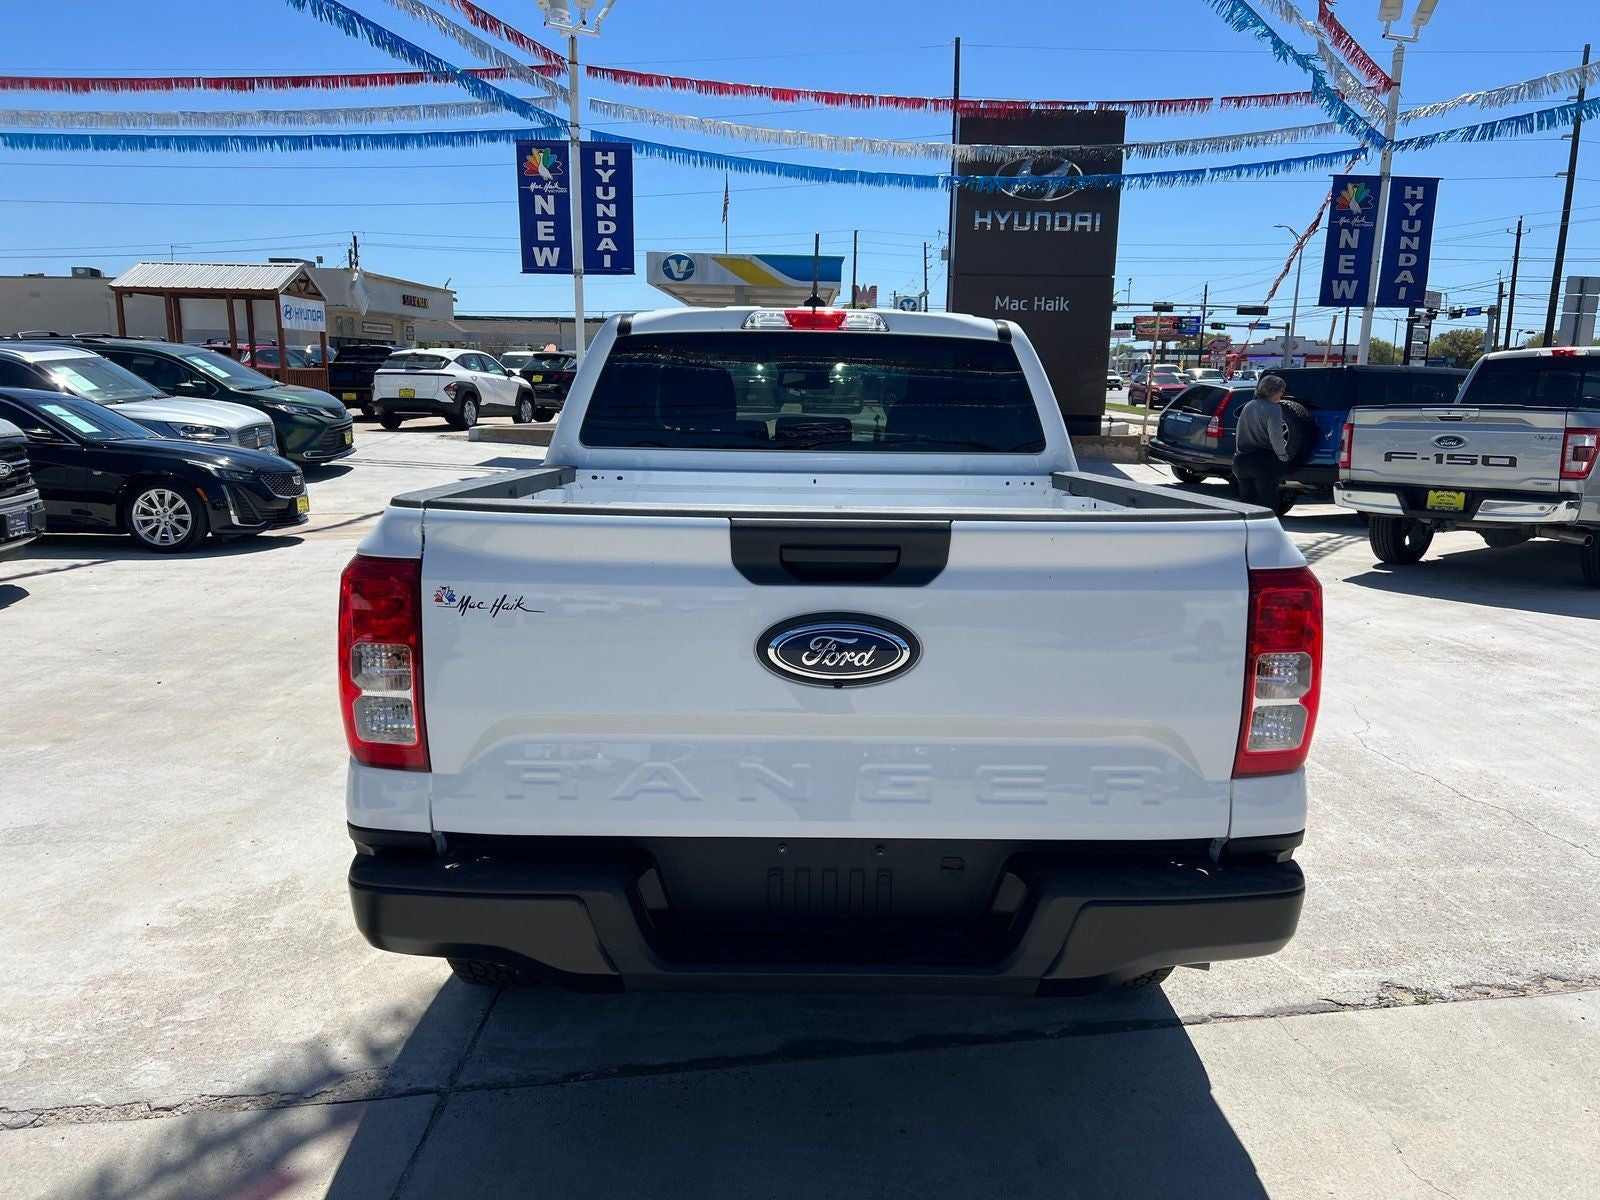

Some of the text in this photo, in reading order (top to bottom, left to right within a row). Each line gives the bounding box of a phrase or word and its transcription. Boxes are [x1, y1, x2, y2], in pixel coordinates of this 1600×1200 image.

[595, 151, 618, 268] HYUNDAI
[974, 209, 1102, 233] HYUNDAI
[532, 194, 560, 267] NEW
[1393, 185, 1424, 300] HYUNDAI
[1332, 228, 1360, 300] NEW
[294, 306, 324, 321] HYUNDAI
[994, 295, 1070, 312] Mac Haik
[1384, 451, 1518, 467] F-150
[447, 594, 538, 618] Mac Haik
[801, 635, 877, 667] Ford
[505, 758, 1164, 807] RANGER
